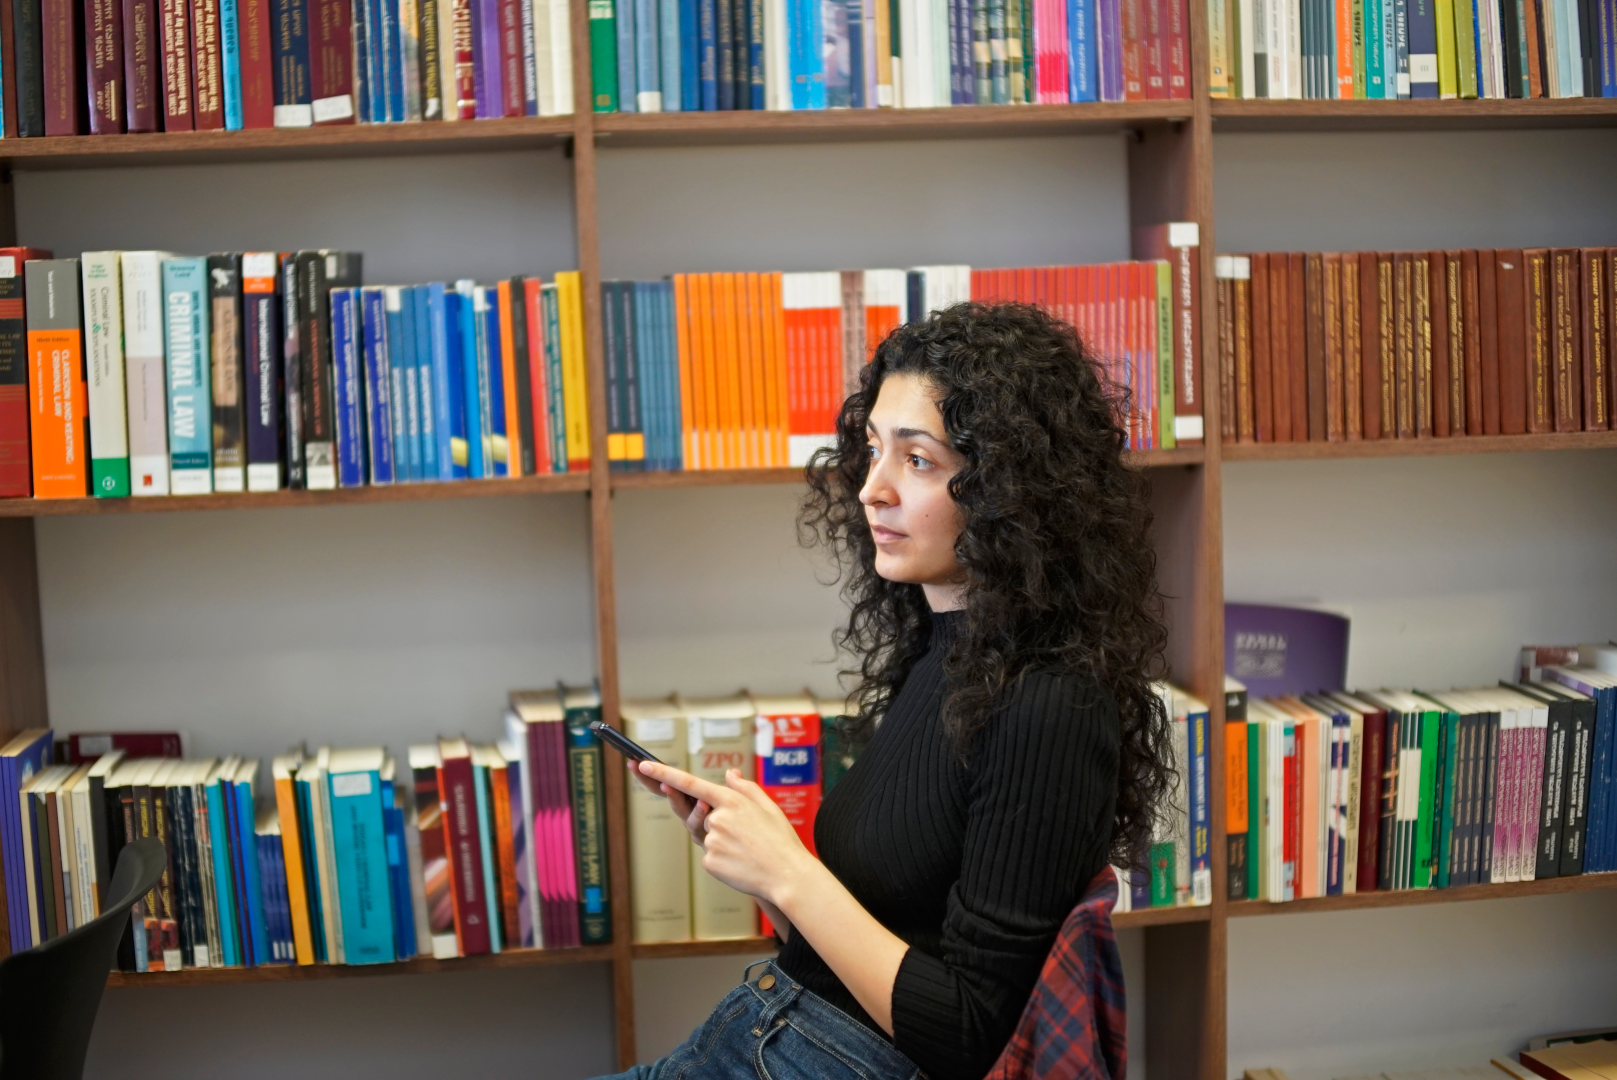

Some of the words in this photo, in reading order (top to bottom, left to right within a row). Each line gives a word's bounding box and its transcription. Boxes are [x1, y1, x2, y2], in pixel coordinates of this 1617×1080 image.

[174, 18, 185, 27] by
[205, 14, 216, 23] by
[206, 25, 215, 42] Trial
[175, 29, 185, 45] Trial
[176, 48, 185, 56] of
[206, 45, 216, 53] of
[176, 58, 187, 98] Institution
[206, 54, 218, 94] Institution
[178, 100, 187, 115] The
[209, 96, 218, 112] The
[90, 288, 99, 324] EXAMPLES
[100, 287, 110, 319] Criminal
[101, 322, 111, 338] Law
[169, 291, 194, 389] CRIMINAL
[224, 310, 235, 364] CRIMINAL
[259, 299, 270, 360] International
[52, 350, 60, 393] CRIMINAL
[61, 350, 71, 399] CLARKSON
[93, 332, 101, 387] EXPLANATIONS
[260, 363, 271, 401] Criminal
[54, 396, 62, 417] LAW
[63, 401, 72, 419] AND
[173, 395, 195, 438] LAW
[261, 404, 272, 426] Law
[64, 421, 73, 464] KEATING:
[1196, 718, 1204, 755] ESSENTIAL
[703, 752, 744, 769] ZPO
[773, 751, 808, 766] BGB
[1196, 756, 1205, 803] EMPLOYMENT
[582, 754, 593, 792] MASS
[589, 855, 599, 885] LAW
[1197, 805, 1205, 821] LAW
